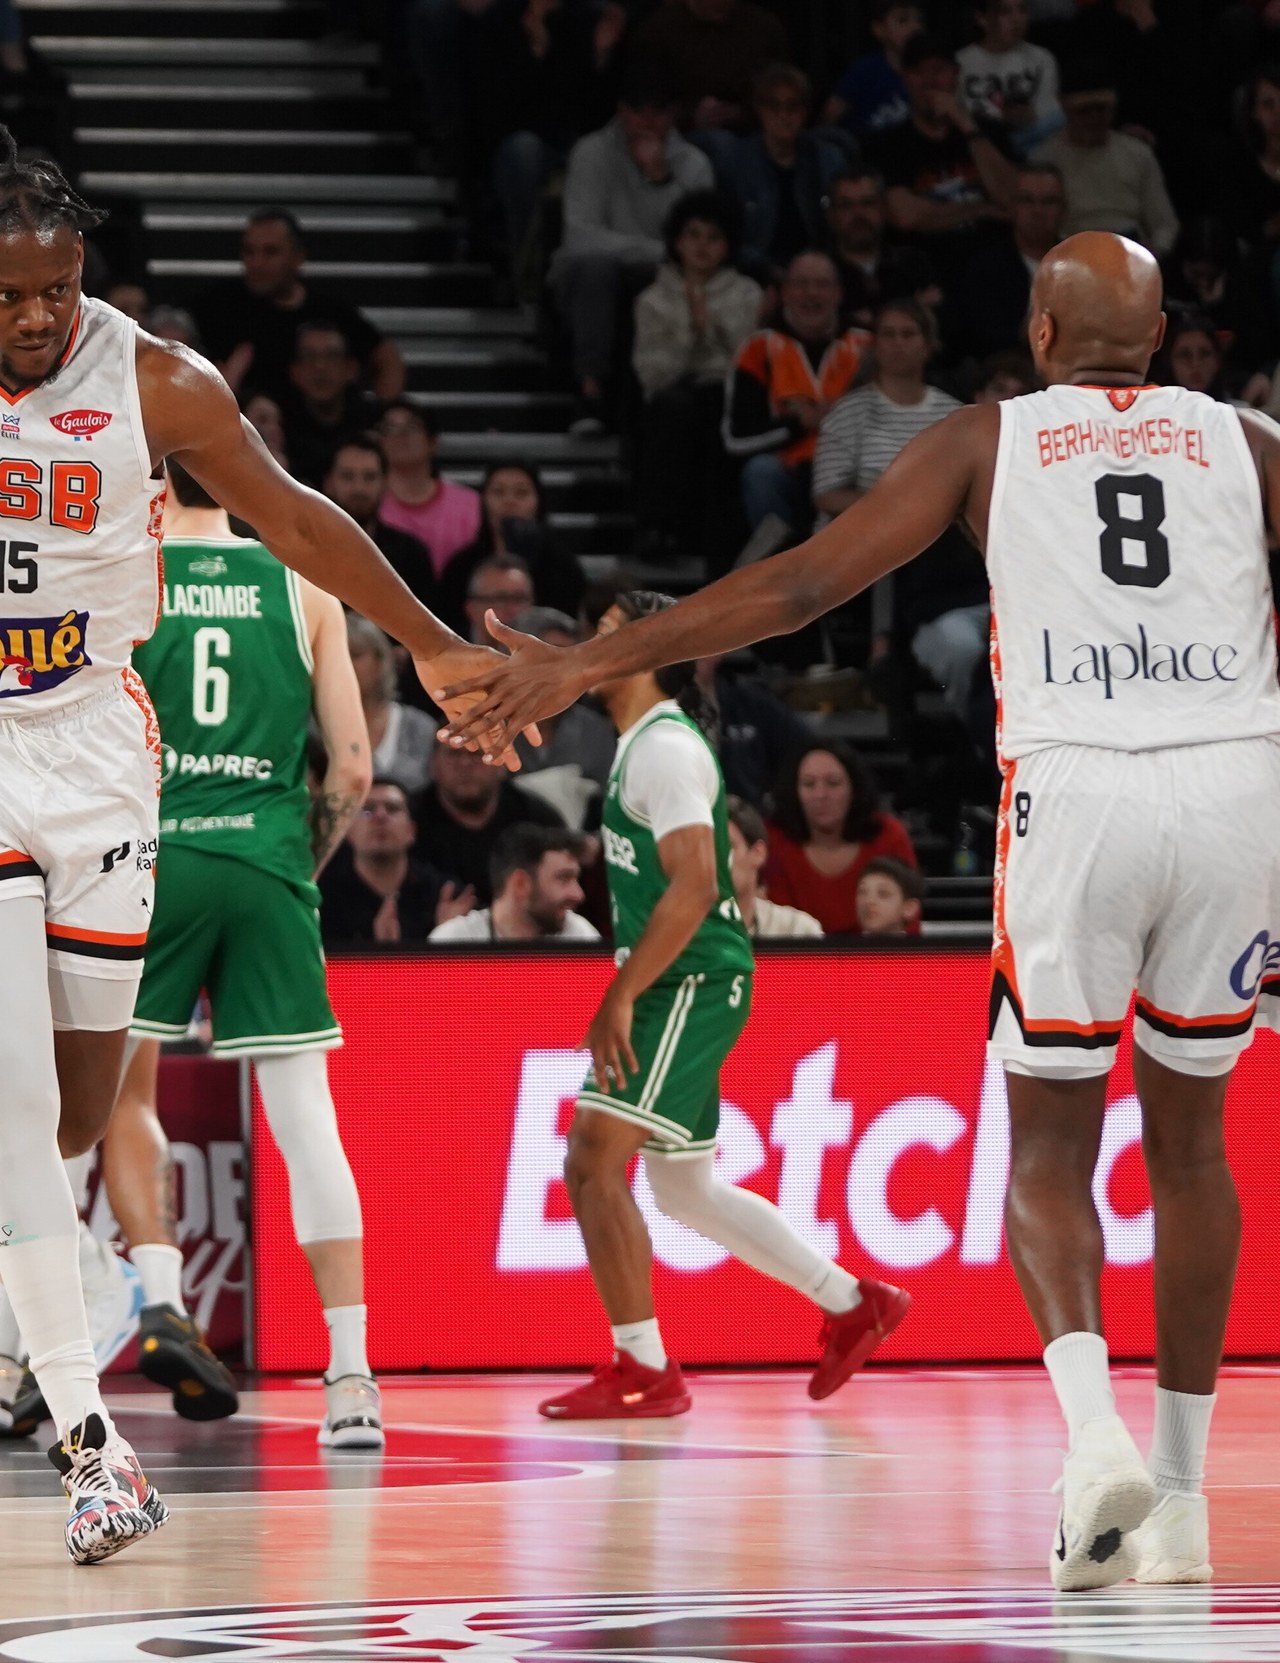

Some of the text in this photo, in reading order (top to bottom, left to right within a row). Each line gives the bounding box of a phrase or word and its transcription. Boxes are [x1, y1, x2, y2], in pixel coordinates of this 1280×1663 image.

[61, 413, 109, 431] Gaulois
[1095, 473, 1171, 588] 8
[163, 584, 263, 618] LACOMBE
[193, 627, 231, 727] 6
[1043, 623, 1239, 700] Laplace
[179, 753, 274, 781] PAPREC
[1015, 791, 1031, 837] 8
[728, 975, 745, 1009] 5
